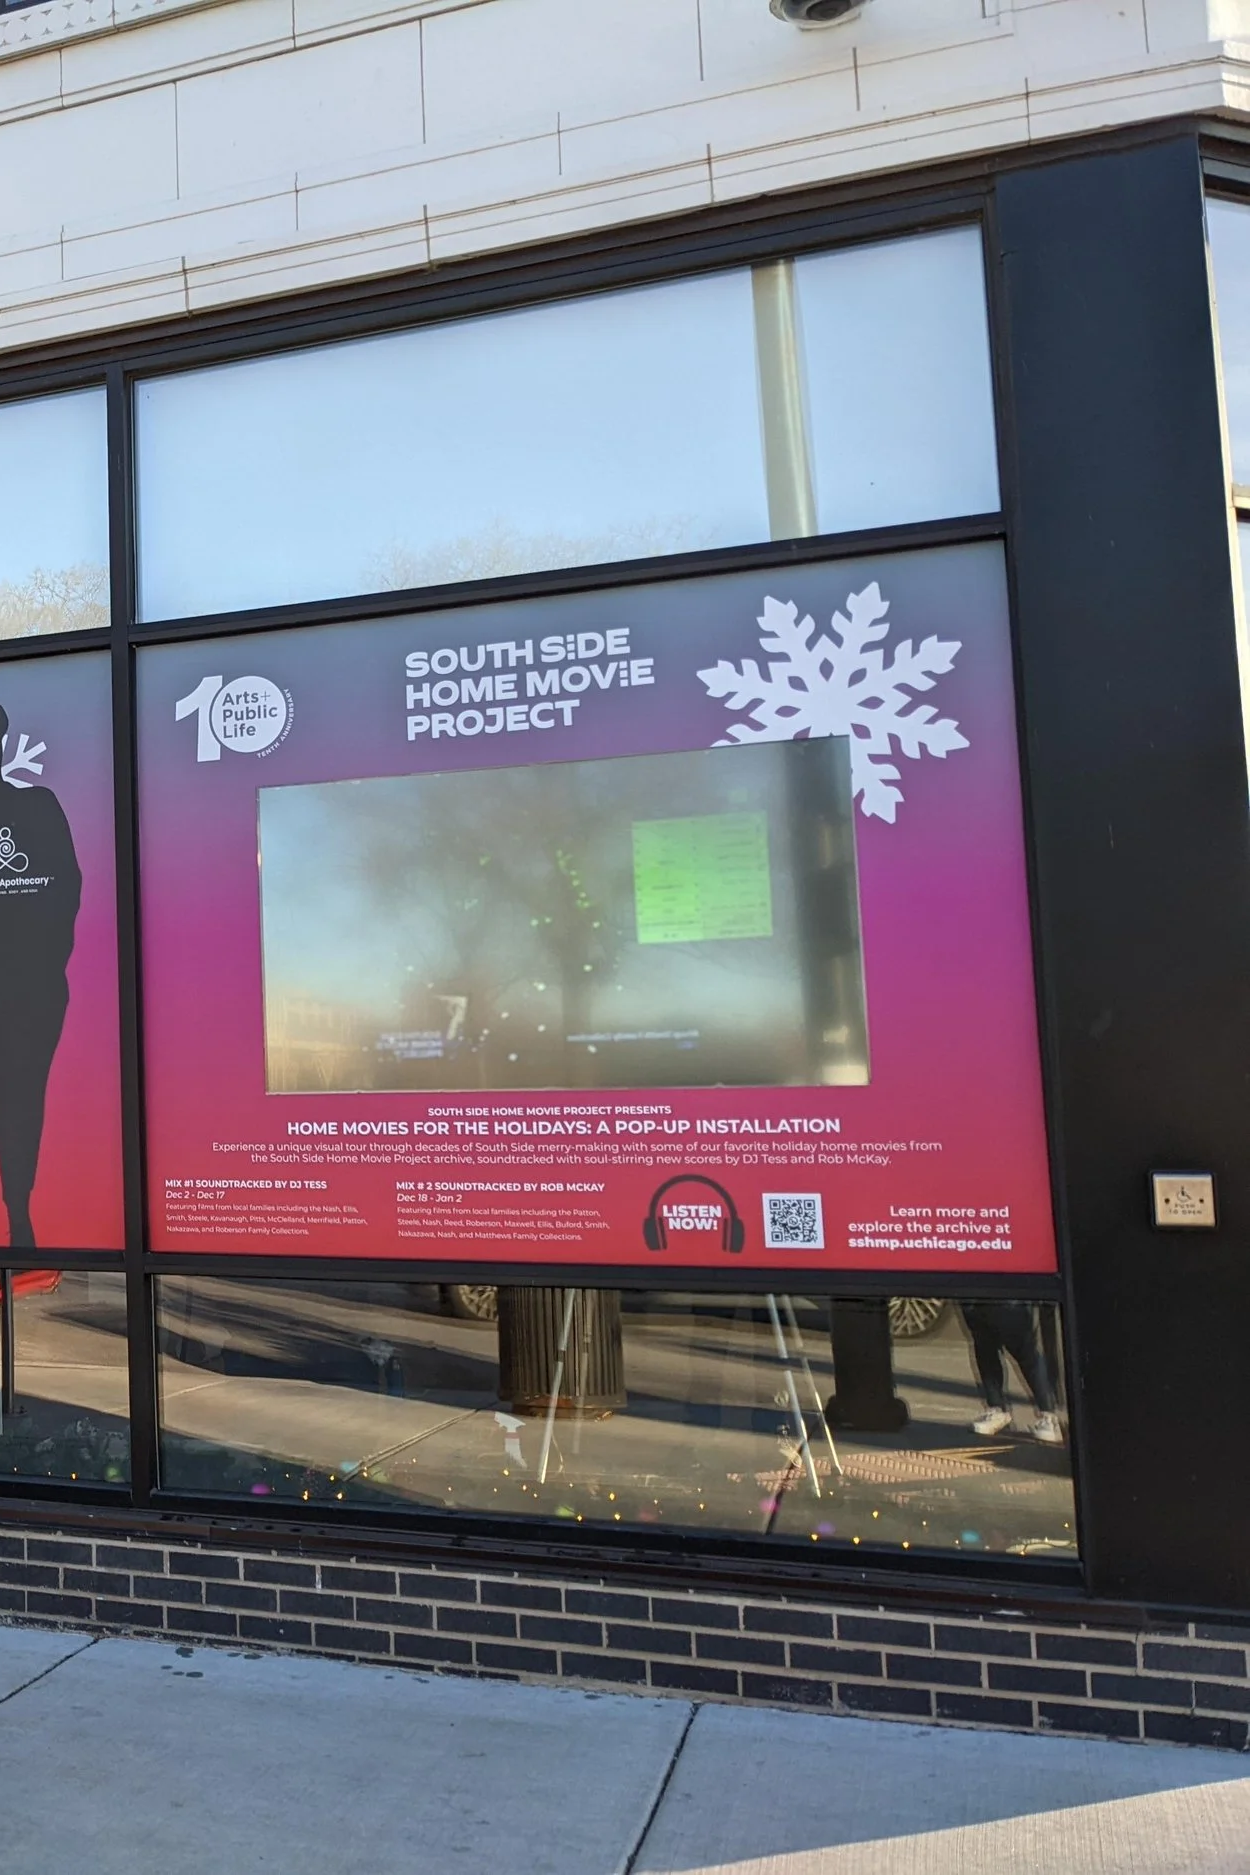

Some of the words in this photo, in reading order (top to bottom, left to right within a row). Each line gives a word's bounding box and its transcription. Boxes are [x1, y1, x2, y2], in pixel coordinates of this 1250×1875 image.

[405, 639, 533, 677] SOUTH
[406, 673, 517, 709] HOME
[223, 705, 278, 722] Public
[407, 698, 579, 740] PROJECT
[257, 742, 280, 758] TENTH
[281, 688, 295, 742] ANNIVERSARY
[223, 723, 256, 738] Life
[428, 1107, 463, 1116] SOUTH
[465, 1107, 489, 1115] SIDE
[491, 1107, 523, 1115] HOME
[526, 1106, 560, 1115] MOVIE
[563, 1106, 612, 1114] PROJECT
[614, 1105, 671, 1114] PRESENTS
[288, 1121, 338, 1134] HOME
[342, 1121, 408, 1134] MOVIES
[413, 1121, 448, 1134] FOR
[453, 1121, 488, 1134] THE
[494, 1120, 591, 1134] HOLIDAYS:
[596, 1120, 610, 1133] A
[615, 1119, 690, 1134] POP-UP
[696, 1118, 840, 1133] INSTALLATION
[212, 1142, 266, 1154] Experience
[276, 1142, 312, 1154] unique
[314, 1142, 342, 1151] visual
[345, 1143, 366, 1151] tour
[367, 1142, 413, 1154] through
[414, 1142, 460, 1151] decades
[462, 1142, 472, 1151] of
[475, 1142, 508, 1151] South
[510, 1142, 534, 1151] Side
[537, 1142, 618, 1154] merry-making
[621, 1141, 647, 1151] with
[650, 1143, 683, 1151] some
[685, 1141, 697, 1151] of
[723, 1141, 768, 1151] favorite
[772, 1141, 817, 1153] holiday
[819, 1141, 857, 1151] home
[860, 1140, 906, 1150] movies
[909, 1140, 942, 1150] from
[251, 1152, 268, 1162] the
[270, 1153, 299, 1162] South
[302, 1153, 324, 1162] Side
[326, 1153, 358, 1162] Home
[360, 1153, 391, 1163] Movie
[394, 1152, 431, 1165] Project
[433, 1153, 474, 1164] archive,
[477, 1154, 553, 1163] soundtracked
[556, 1153, 581, 1164] with
[584, 1152, 653, 1166] soul-stirring
[684, 1155, 722, 1164] scores
[724, 1154, 739, 1166] by
[742, 1153, 758, 1163] DJ
[760, 1153, 787, 1163] Tess
[790, 1152, 814, 1164] and
[817, 1153, 843, 1164] Rob
[846, 1154, 891, 1165] McKay.
[195, 1179, 272, 1188] SOUNDTRACKED
[289, 1180, 301, 1188] DJ
[303, 1180, 326, 1188] TESS
[396, 1181, 414, 1189] MIX
[426, 1182, 432, 1190] 2
[434, 1182, 521, 1191] SOUNDTRACKED
[523, 1183, 537, 1191] BY
[540, 1182, 563, 1191] ROB
[566, 1182, 604, 1191] MCKAY
[165, 1190, 182, 1198] Dec
[184, 1190, 189, 1198] 2
[196, 1190, 214, 1198] Dec
[216, 1190, 224, 1198] 17
[396, 1193, 415, 1202] Dec
[417, 1193, 427, 1202] 18
[435, 1193, 453, 1202] Jan
[455, 1194, 461, 1202] 2
[165, 1202, 196, 1210] Featuring
[397, 1206, 431, 1215] Featuring
[520, 1208, 556, 1217] including
[662, 1204, 721, 1219] LISTEN
[890, 1205, 931, 1216] Learn
[935, 1208, 975, 1217] more
[979, 1206, 1008, 1217] and
[668, 1217, 717, 1230] NOW!
[848, 1220, 903, 1234] explore
[906, 1221, 931, 1232] the
[935, 1221, 990, 1233] archive
[995, 1223, 1010, 1233] at
[848, 1236, 1011, 1251] sshmp.uchicago.edu
